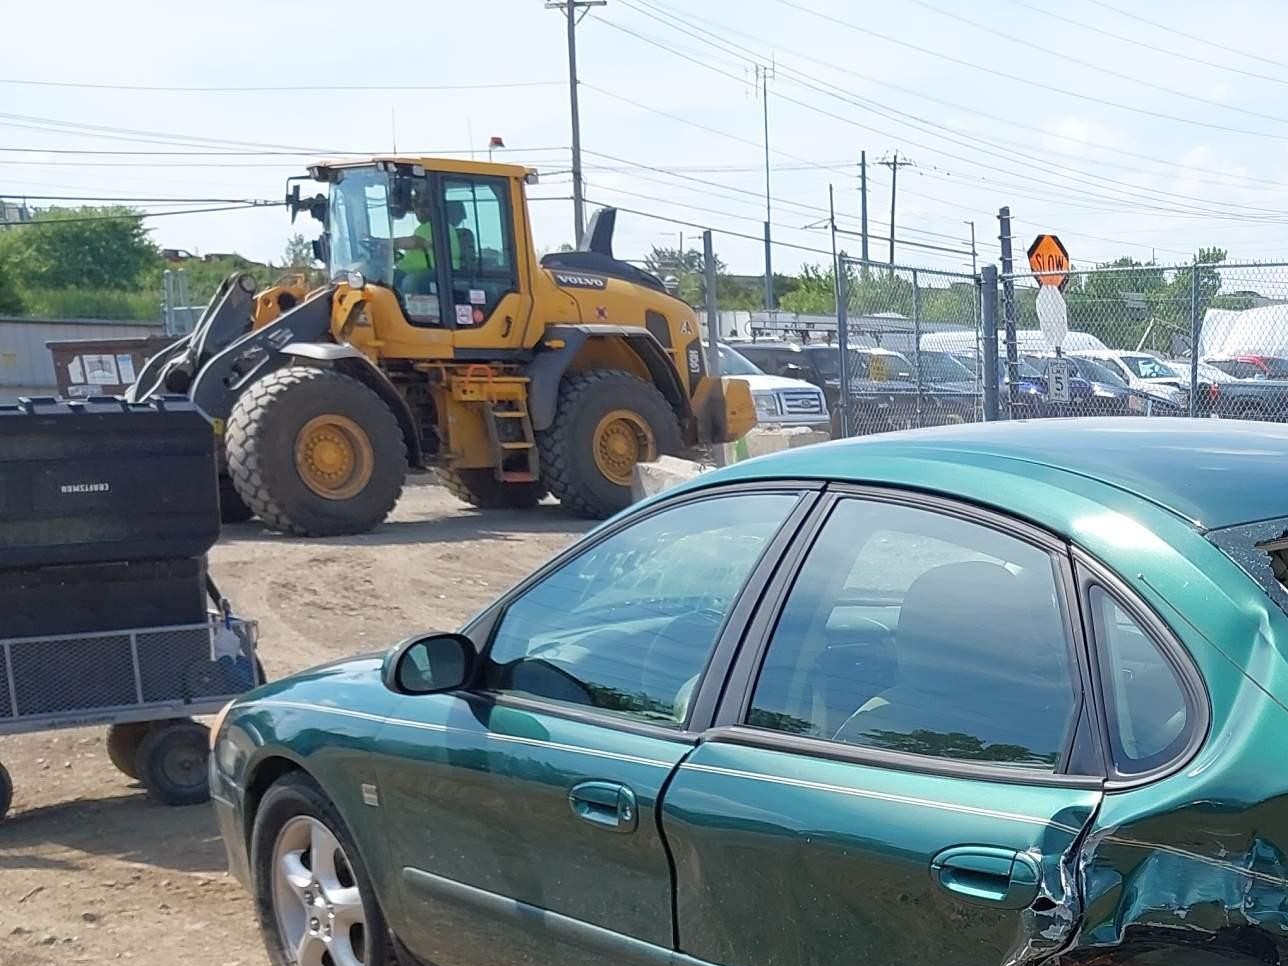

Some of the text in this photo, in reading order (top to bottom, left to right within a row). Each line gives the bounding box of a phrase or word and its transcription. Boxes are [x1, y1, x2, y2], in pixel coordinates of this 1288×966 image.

[1035, 253, 1064, 272] SLOW
[556, 274, 604, 287] VOLVO
[1054, 376, 1064, 392] 5
